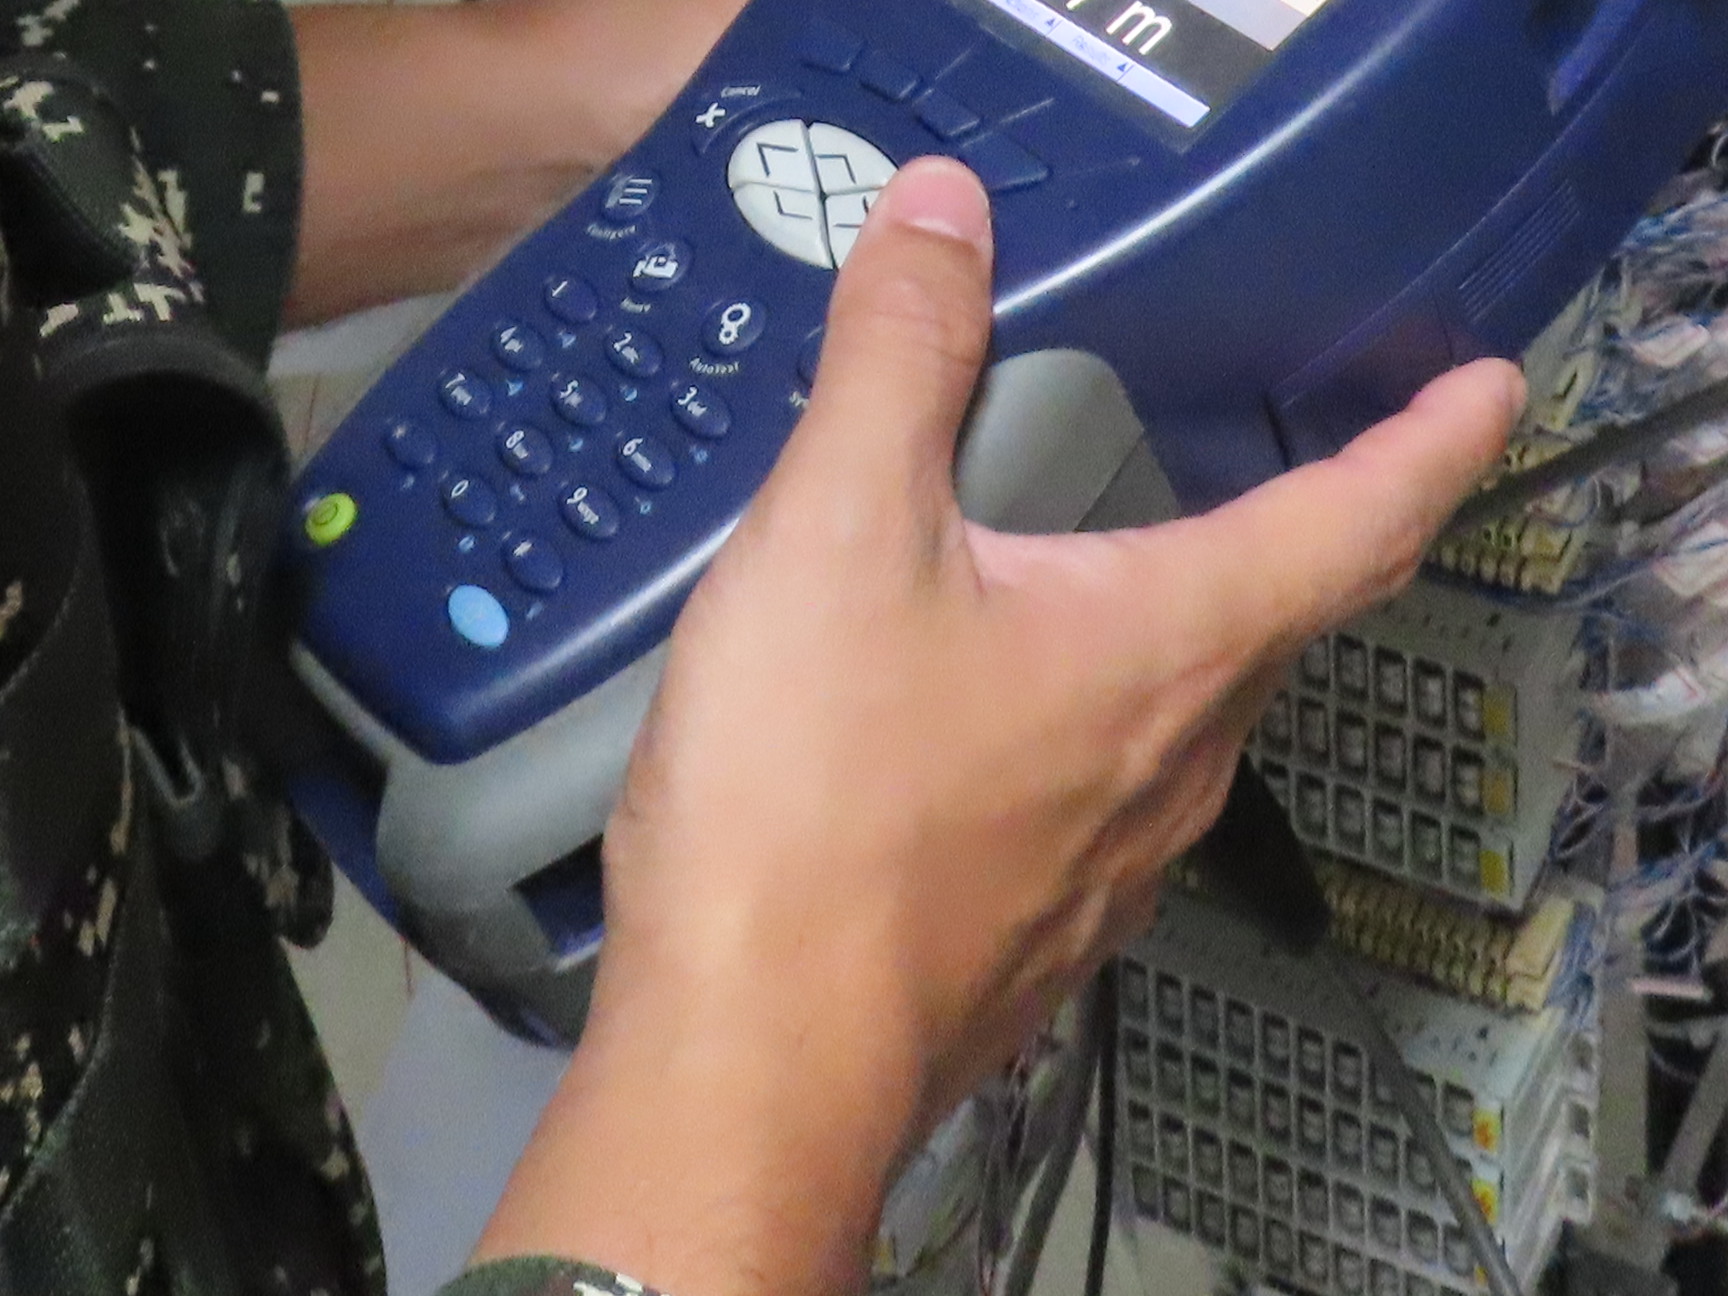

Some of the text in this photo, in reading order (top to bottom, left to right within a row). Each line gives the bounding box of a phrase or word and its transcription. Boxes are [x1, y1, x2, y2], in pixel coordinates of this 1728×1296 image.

[1104, 0, 1174, 56] m
[551, 280, 569, 297] 1
[450, 478, 470, 499] 0
